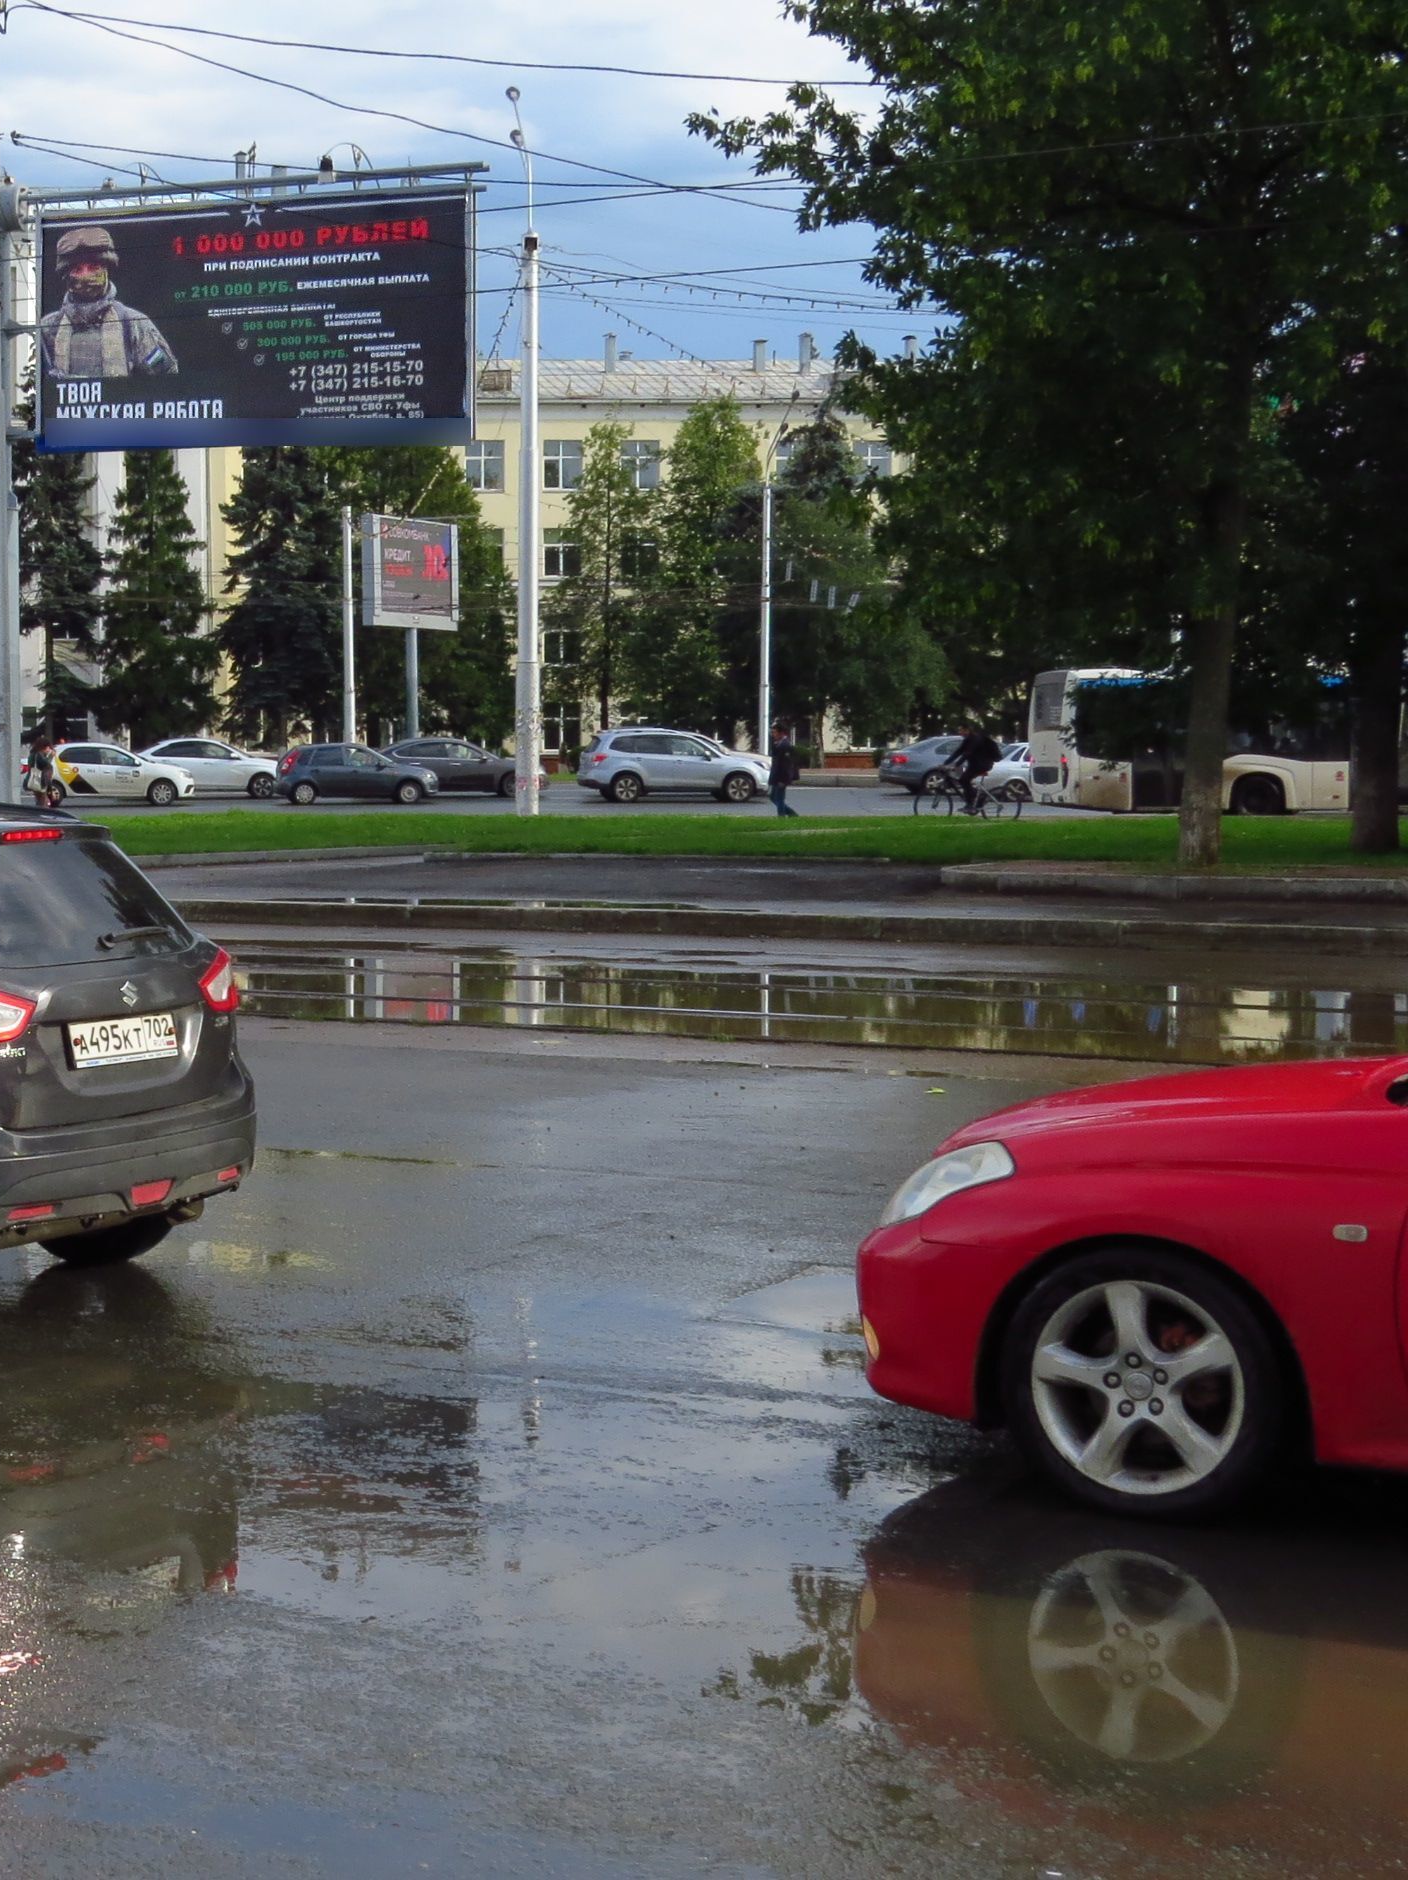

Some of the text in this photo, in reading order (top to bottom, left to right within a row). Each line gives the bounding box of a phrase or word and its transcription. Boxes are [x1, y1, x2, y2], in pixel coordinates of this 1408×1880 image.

[197, 232, 244, 254] 000
[255, 229, 305, 249] 000
[316, 217, 429, 246] РУБЛЕЙ
[204, 251, 381, 272] ПРИ ПОДПИСАНИИ КОНТРАКТА
[190, 285, 220, 298] 210
[223, 282, 253, 296] 000
[258, 280, 293, 294] РУБ.
[296, 276, 376, 290] ЕЖЕМЕСЯЧНАЯ
[378, 273, 430, 285] ВЫПЛАТА
[289, 360, 424, 379] +7 (347) 215-15-70
[56, 382, 102, 404] ТВОЯ
[289, 374, 424, 393] +7 (347) 215-16-70
[56, 399, 223, 418] МУЖСКАЯ РАБОТА
[300, 405, 358, 416] участников
[361, 402, 383, 411] СВО
[395, 401, 420, 411] Уфы
[314, 393, 405, 404] Центр поддержки
[79, 1017, 170, 1055] А495КТ 702
